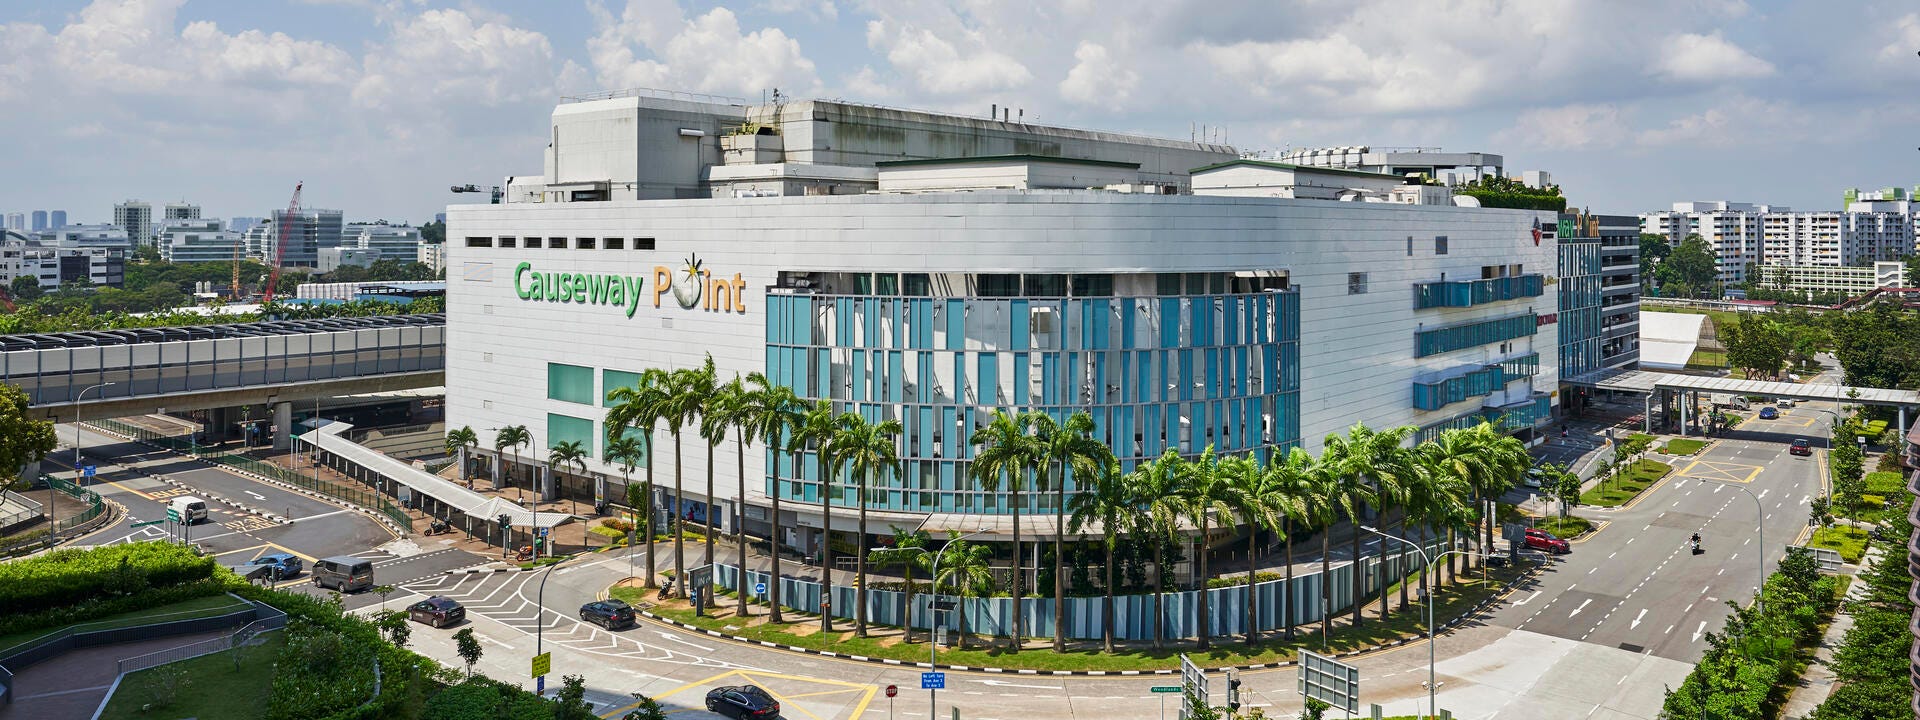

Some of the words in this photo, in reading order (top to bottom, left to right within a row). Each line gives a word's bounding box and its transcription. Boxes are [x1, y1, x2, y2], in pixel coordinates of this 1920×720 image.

[514, 261, 643, 318] Causeway
[653, 255, 746, 314] Point
[148, 487, 192, 499] BUS
